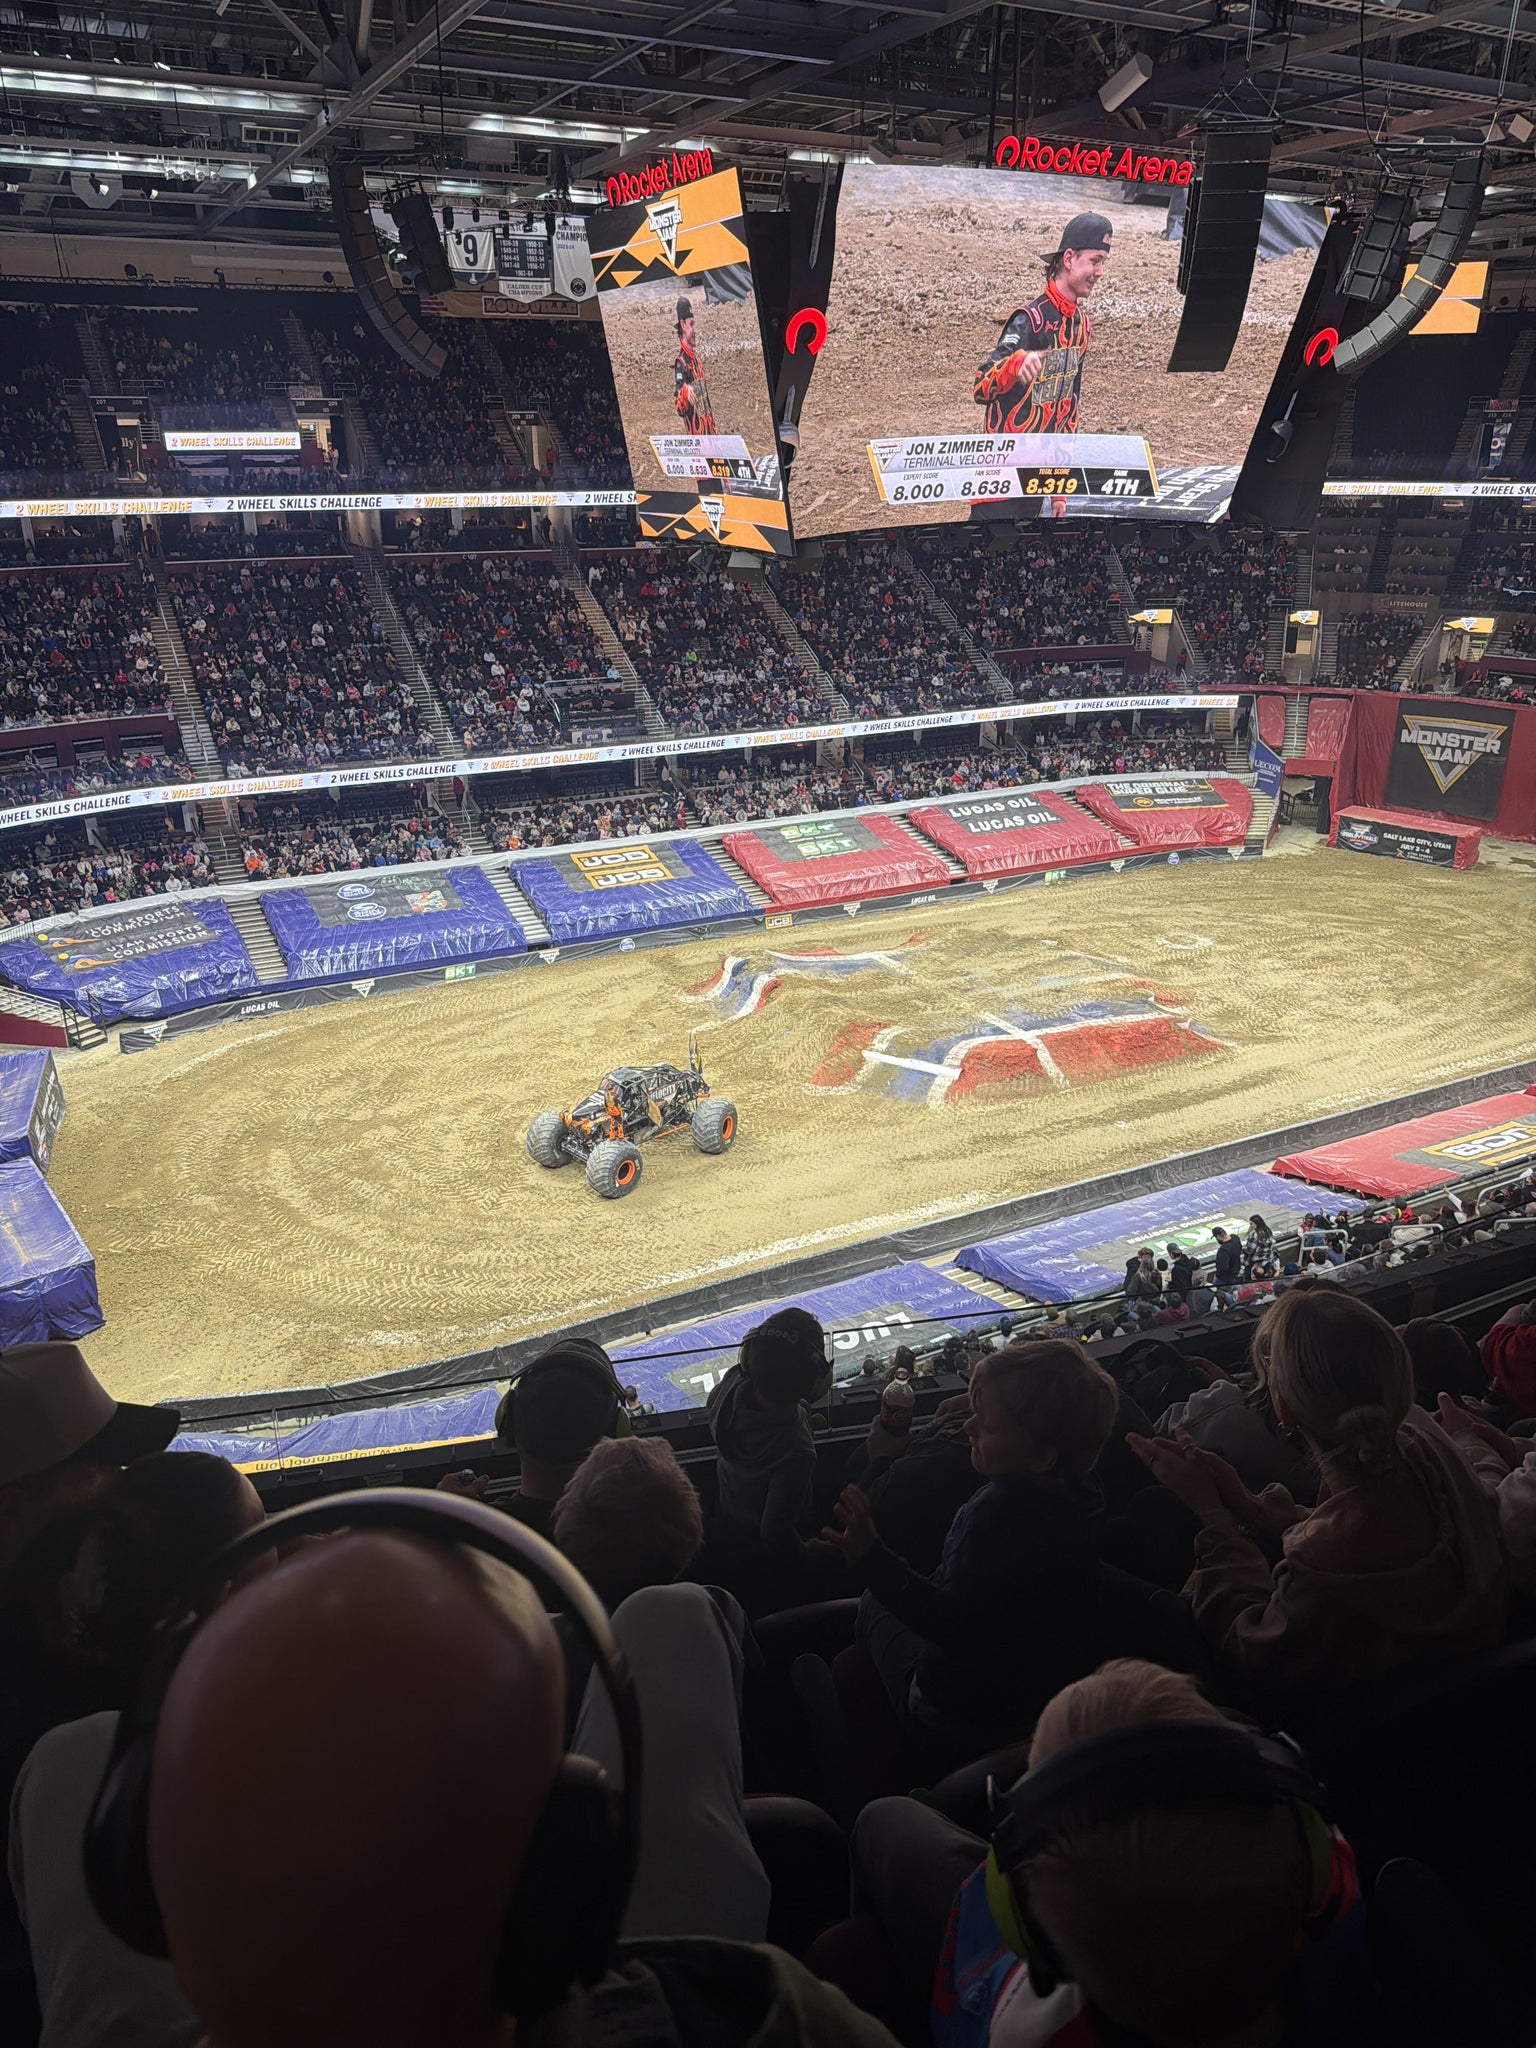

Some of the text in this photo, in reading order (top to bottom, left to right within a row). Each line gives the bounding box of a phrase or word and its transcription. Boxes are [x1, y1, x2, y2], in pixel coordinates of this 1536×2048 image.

[1019, 136, 1192, 185] Rocket Arena
[618, 148, 713, 202] Rocket Arena
[649, 209, 683, 231] MONSTER
[463, 234, 479, 267] 9
[171, 436, 296, 447] 2 WHEEL SKILLS CHALLENGE
[664, 439, 674, 447] JON
[674, 439, 694, 447] ZIMMER
[906, 439, 1016, 456] JON ZIMMER JR
[666, 464, 685, 475] 8.000
[903, 453, 1010, 469] TERMINAL VELOCITY
[689, 465, 708, 476] 8.638
[711, 465, 731, 478] 8.319
[737, 466, 752, 479] 4TH
[923, 471, 939, 480] SCORE
[1038, 468, 1053, 476] TOTAL
[893, 483, 945, 500] 8.000
[960, 480, 1012, 496] 8.638
[1025, 478, 1079, 495] 8.319
[1100, 479, 1140, 495] 4TH
[1350, 485, 1443, 495] SKILLS CHALLENGE
[1471, 485, 1515, 495] 2 WHEEL
[227, 497, 382, 510] 2 WHEEL SKILLS CHALLENGE
[414, 495, 557, 507] 2 WHEEL SKILLS CHALLENGE
[584, 493, 625, 504] 2 WHEEL
[15, 501, 193, 516] 2 WHEEL SKILLS CHALLENGE
[1389, 600, 1429, 608] LITEHOUSE
[1074, 698, 1170, 710] 2 WHEEL SKILLS CHALLENGE
[863, 715, 953, 732] 2 WHEEL SKILLS CHALLENGE
[746, 727, 845, 745] 2 WHEEL SKILLS CHALLENGE
[1400, 729, 1501, 754] MONSTER
[621, 738, 725, 757] 2 WHEEL SKILLS CHALLENGE
[1426, 746, 1472, 764] JAM
[482, 751, 600, 771] 2 WHEEL SKILLS CHALLENGE
[1254, 759, 1281, 773] LECOM
[331, 764, 457, 783] 2 WHEEL SKILLS CHALLENGE
[161, 778, 304, 800] 2 WHEEL SKILLS CHALLENGE
[35, 803, 71, 818] SKILLS
[73, 794, 131, 811] CHALLENGE
[949, 801, 1006, 818] LUCAS
[968, 811, 1058, 833] LUCAS OIL
[798, 839, 855, 856] BKT
[1383, 832, 1452, 850] SALT LAKE CITY, UTAH
[583, 850, 650, 867] JCB
[597, 868, 665, 886] JCB
[910, 894, 937, 905] LUCAS OIL
[129, 904, 181, 925] SPORTS
[768, 917, 791, 928] JCB
[106, 924, 203, 953] UTAH SPORTS
[113, 929, 208, 959] COMMISSION
[445, 964, 475, 980] BKT
[241, 1000, 281, 1014] LUCAS OIL
[1441, 1127, 1531, 1157] JCB
[1126, 1212, 1227, 1245] GROWING TOGETHER
